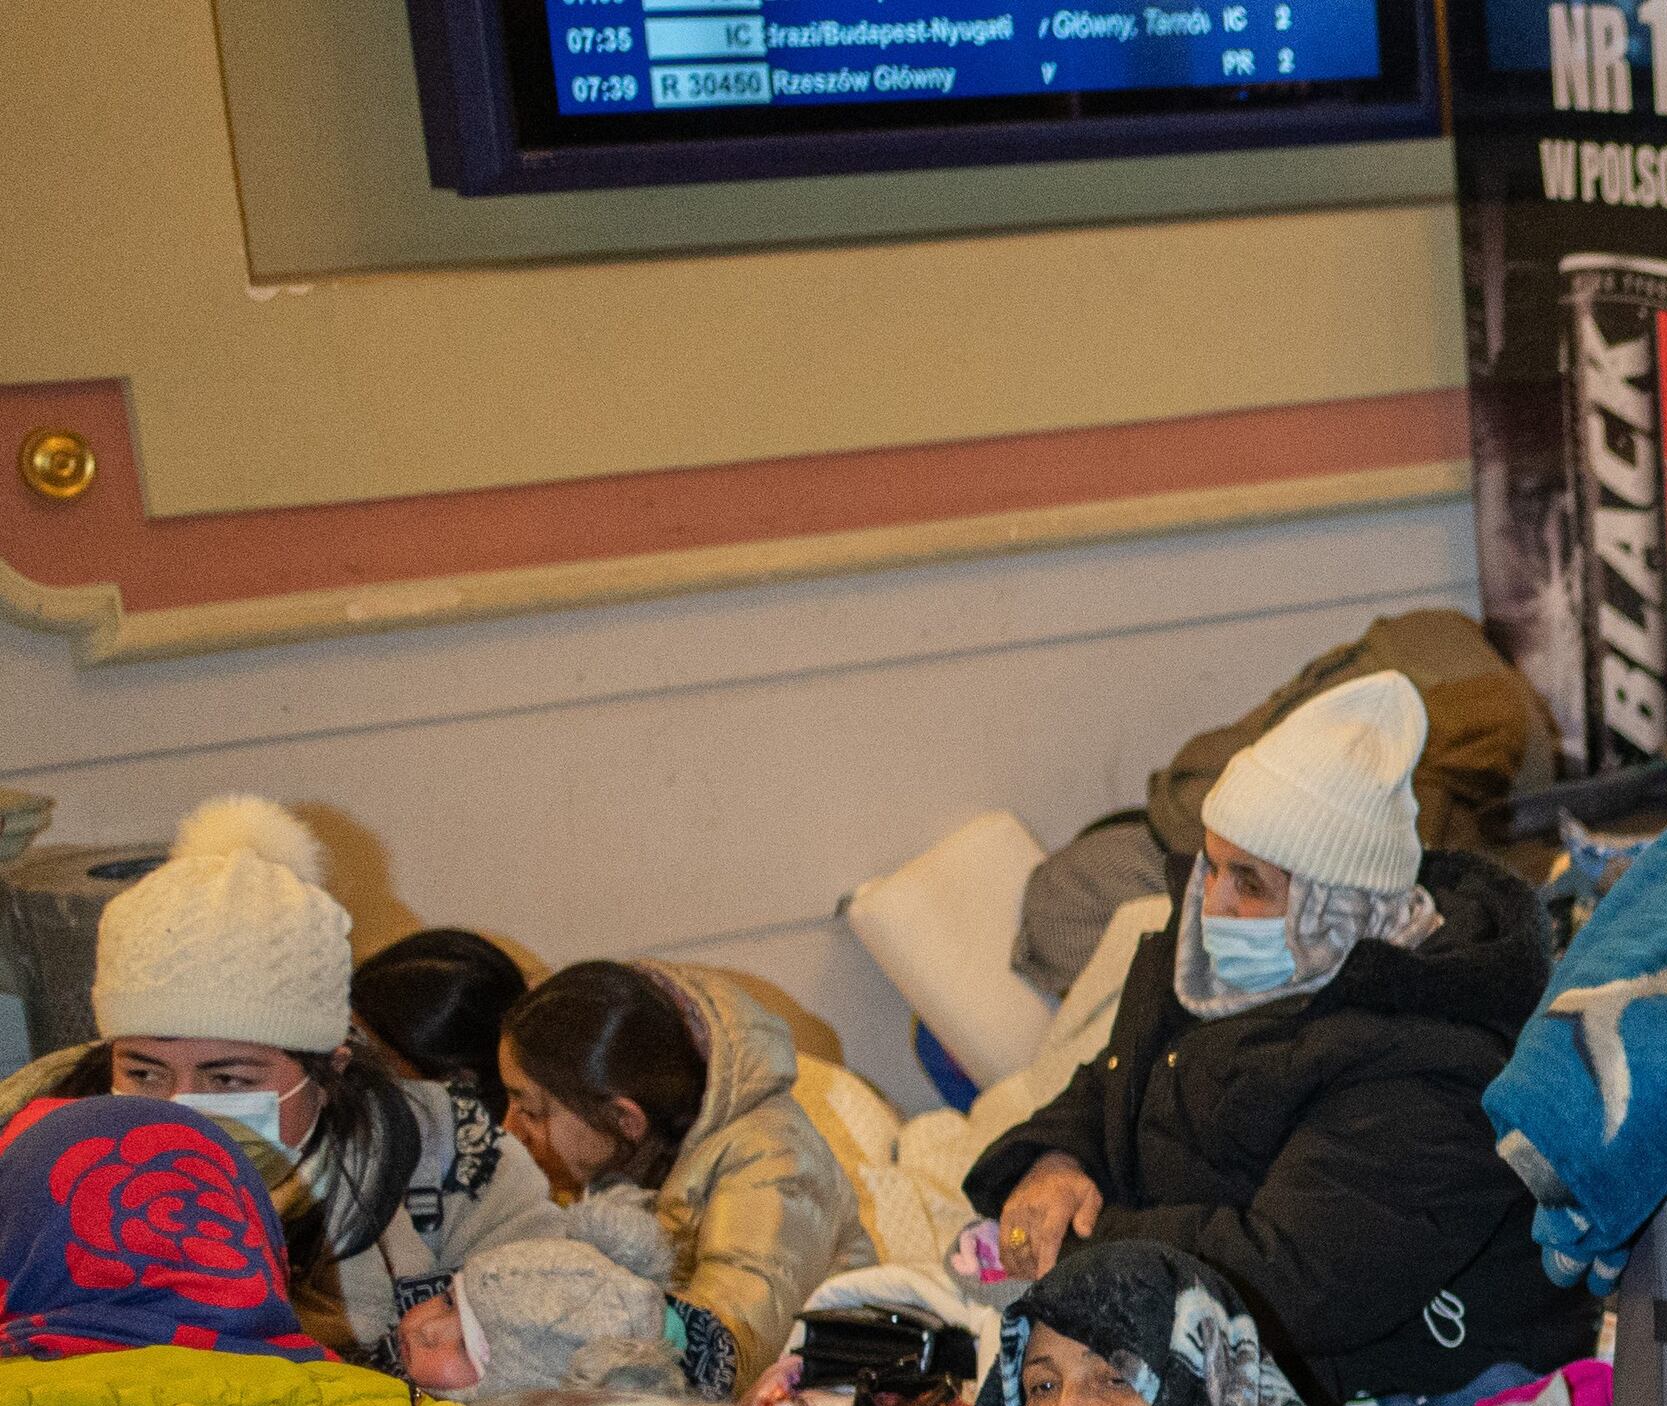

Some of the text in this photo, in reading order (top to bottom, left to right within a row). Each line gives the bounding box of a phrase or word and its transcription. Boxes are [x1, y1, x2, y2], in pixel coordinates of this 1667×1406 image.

[725, 23, 752, 49] IC
[1547, 3, 1633, 114] NR
[660, 74, 681, 99] R
[1538, 138, 1578, 202] W
[1576, 309, 1667, 757] BLACK
